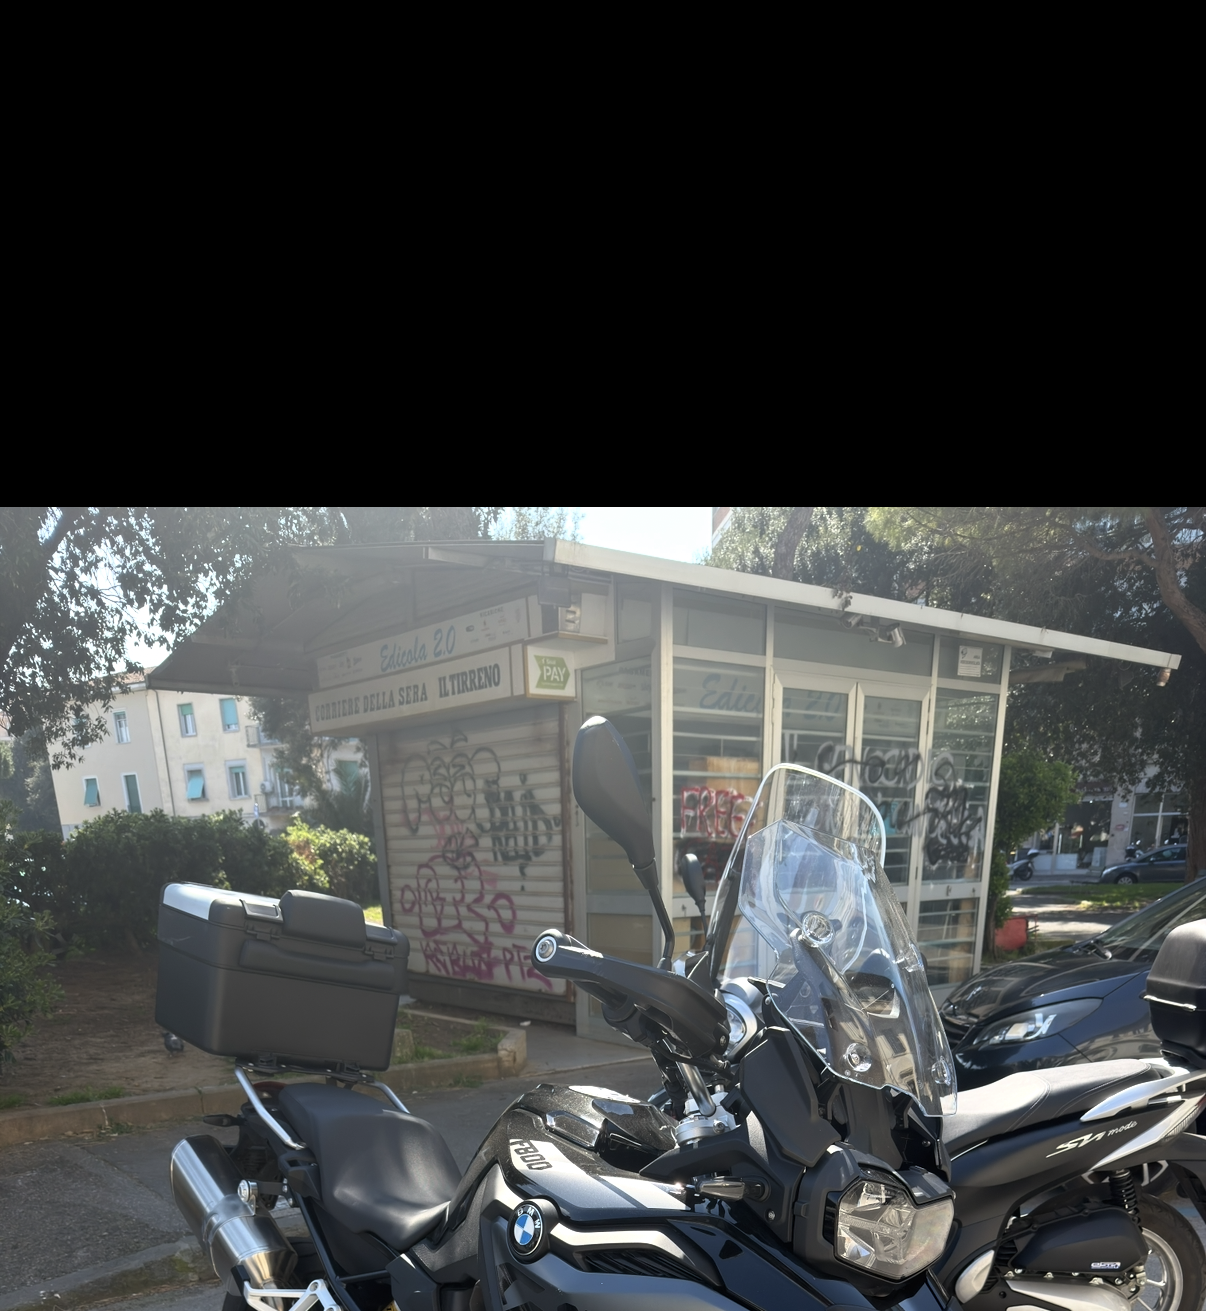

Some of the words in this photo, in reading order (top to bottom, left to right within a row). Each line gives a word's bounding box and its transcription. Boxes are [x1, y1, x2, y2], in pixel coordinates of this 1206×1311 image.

[380, 636, 428, 673] Edicola
[433, 625, 457, 658] 2.0
[543, 665, 567, 682] PAY
[315, 696, 360, 722] CORRIERE
[363, 690, 396, 713] DELLA
[398, 682, 428, 706] SERA
[1107, 1120, 1138, 1136] mode
[517, 1206, 541, 1229] BMW
